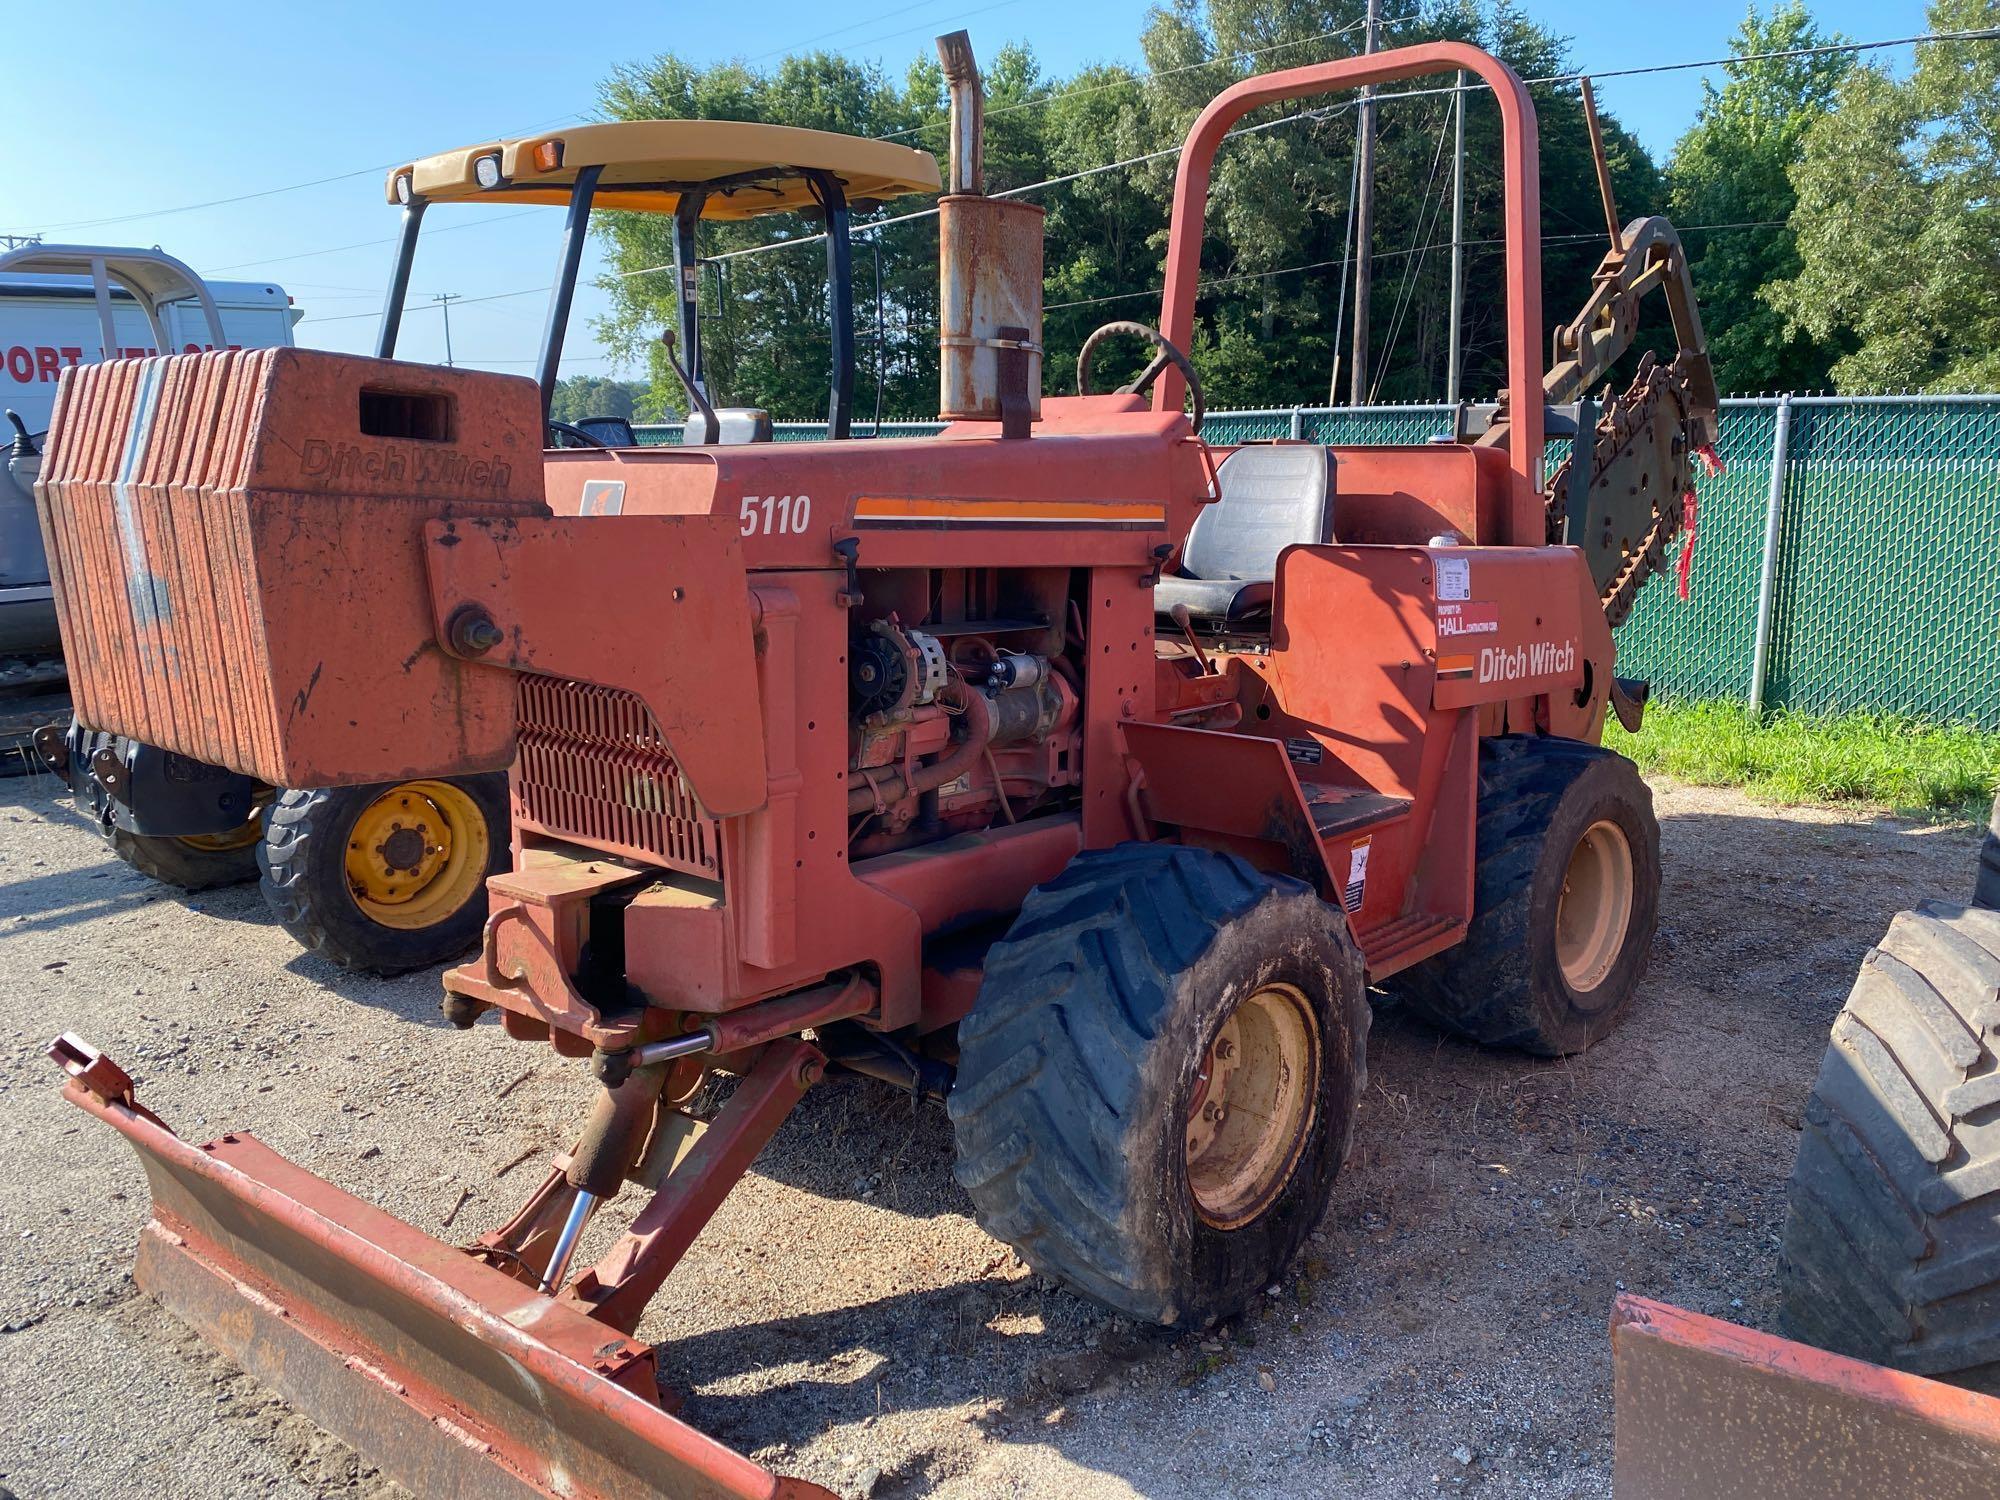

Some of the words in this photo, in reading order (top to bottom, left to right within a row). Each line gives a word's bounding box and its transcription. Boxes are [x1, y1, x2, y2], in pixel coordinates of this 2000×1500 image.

[0, 345, 82, 384] ORT
[300, 439, 406, 481] Ditch
[411, 447, 513, 488] Witch
[739, 495, 811, 537] 5110
[1438, 617, 1466, 636] HALL
[1479, 645, 1527, 684] Ditch
[1529, 640, 1575, 677] Witch
